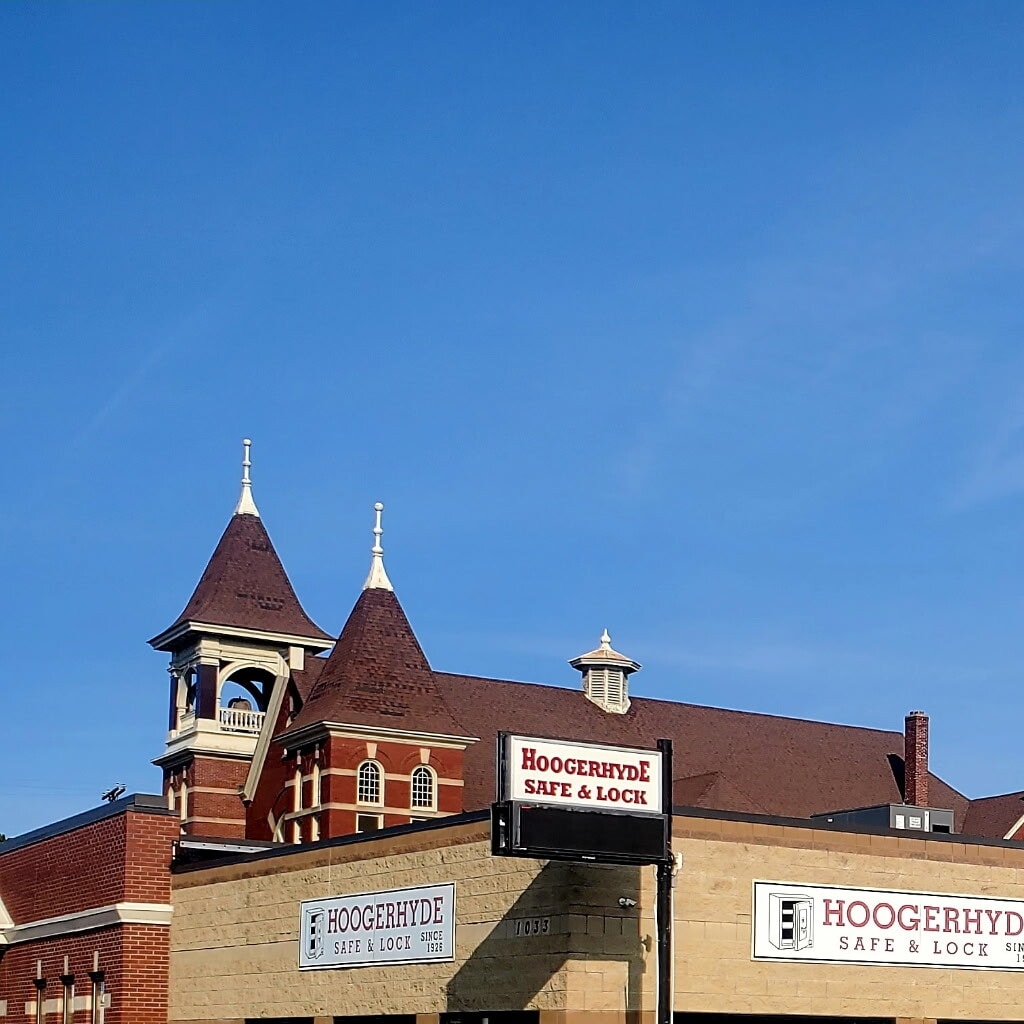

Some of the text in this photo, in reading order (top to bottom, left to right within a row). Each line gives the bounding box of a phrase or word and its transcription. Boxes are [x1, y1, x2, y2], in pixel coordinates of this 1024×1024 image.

[521, 748, 650, 782] HOOGERHYDE
[525, 779, 648, 805] SAFE & LOCK
[327, 896, 444, 934] HOOGERHYDE
[420, 930, 443, 942] SINCE
[516, 919, 549, 936] 1033
[334, 935, 411, 955] SAFE & LOCK
[839, 936, 989, 957] SAFE & LOCK
